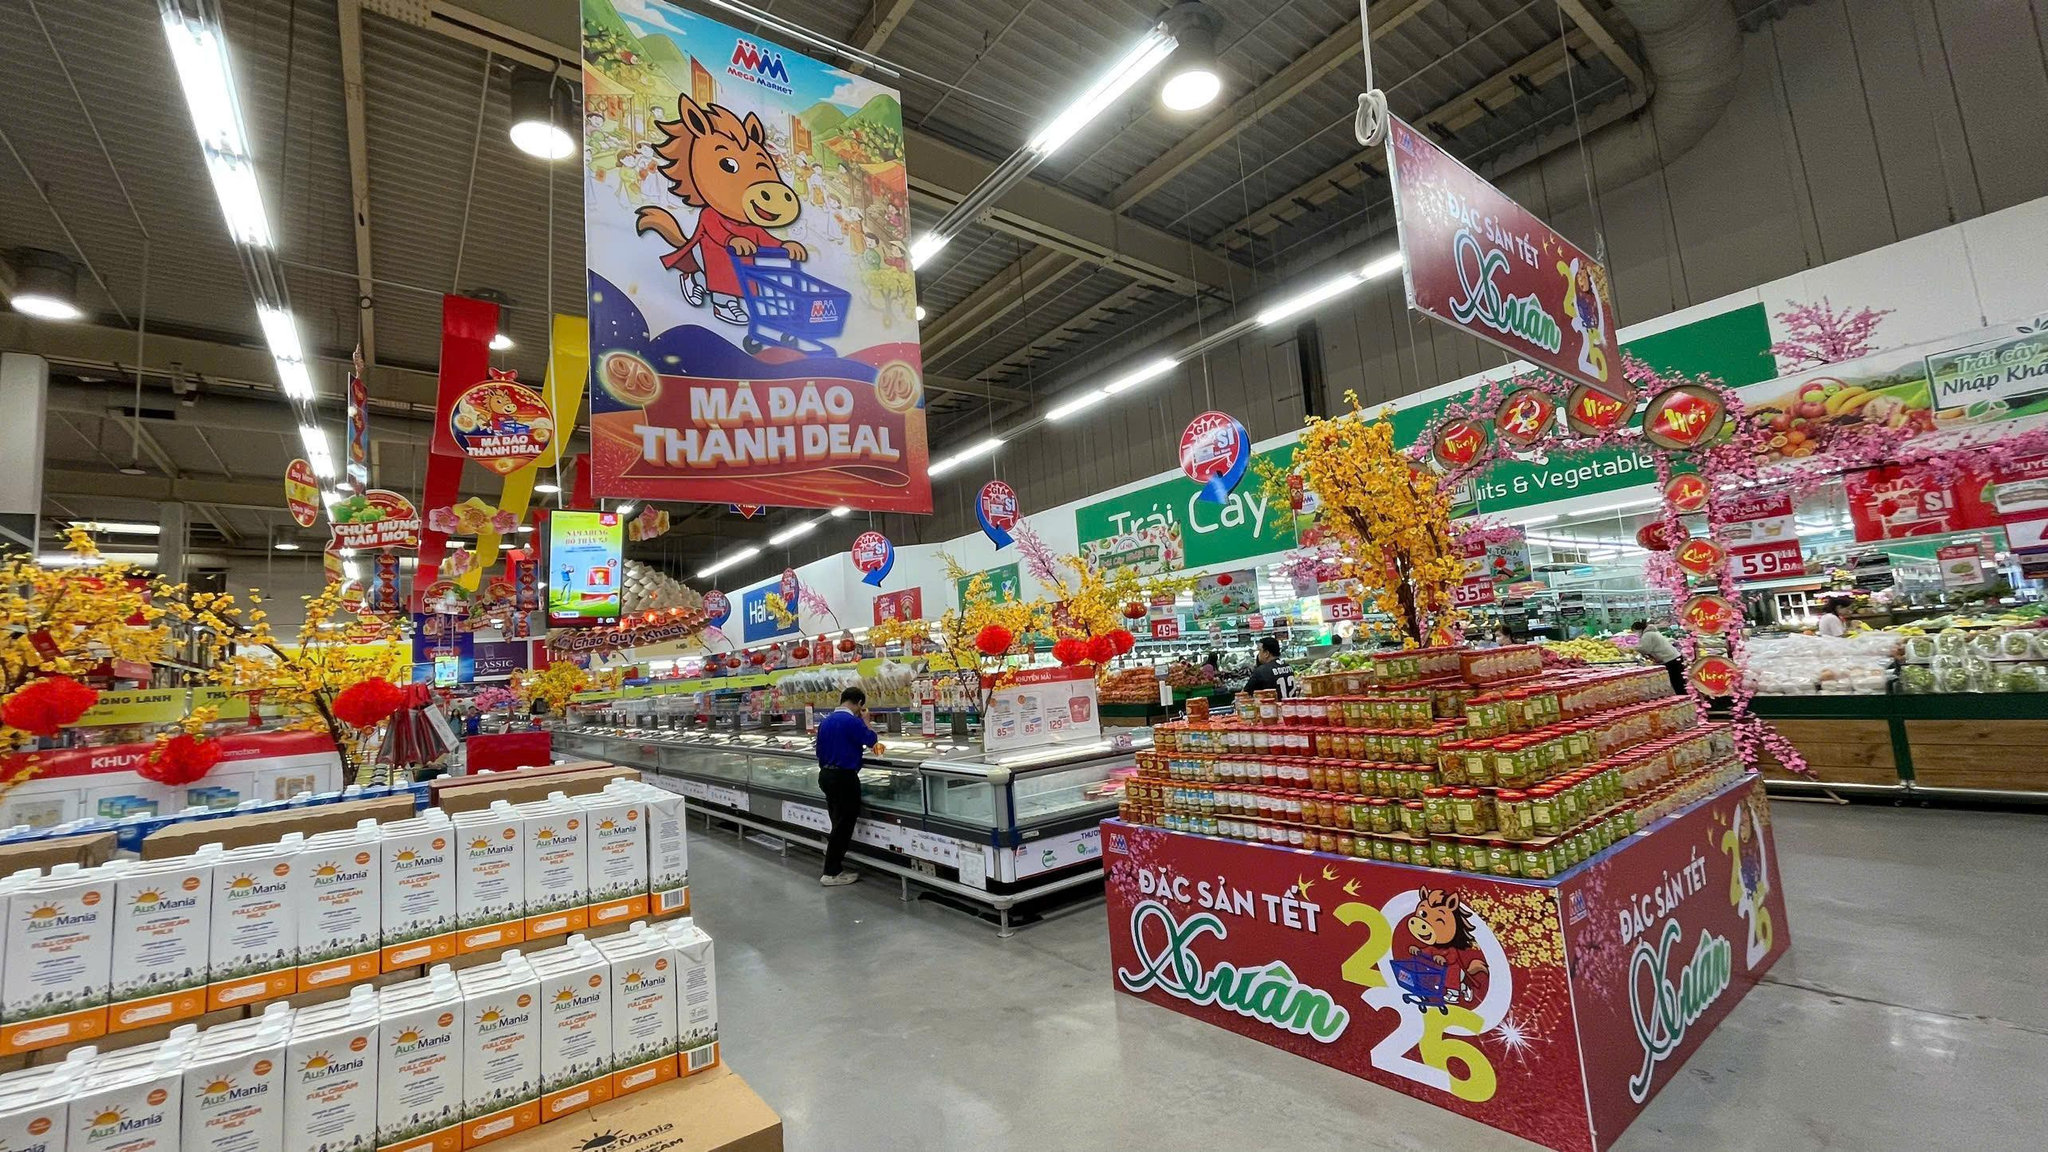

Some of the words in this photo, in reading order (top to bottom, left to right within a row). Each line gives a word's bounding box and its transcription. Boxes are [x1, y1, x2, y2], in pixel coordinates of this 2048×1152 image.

[1446, 192, 1482, 234] ĐẶC
[1485, 217, 1515, 258] SẢN
[1515, 234, 1539, 269] TẾT
[1449, 227, 1562, 355] Xuân
[1955, 349, 1997, 374] Trái
[1999, 341, 2043, 365] cây
[1943, 373, 2000, 397] Nhập
[633, 423, 795, 467] THÀNH
[802, 424, 900, 463] DEAL
[1514, 476, 1530, 494] &
[1531, 452, 1654, 490] Vegetable
[1742, 553, 1777, 574] 59
[1331, 603, 1350, 618] 65
[1157, 624, 1171, 638] 49
[474, 659, 513, 669] LASSIC
[1276, 675, 1297, 698] 12
[997, 727, 1007, 737] 85
[1025, 723, 1034, 733] 85
[1049, 719, 1062, 730] 129
[536, 839, 552, 848] Aus
[552, 834, 577, 845] Mania
[598, 829, 613, 839] Aus
[613, 825, 638, 836] Mania
[469, 848, 486, 859] Aus
[487, 844, 513, 856] Mania
[395, 859, 412, 870] Aus
[413, 855, 444, 867] Mania
[314, 873, 335, 886] Aus
[336, 869, 368, 883] Mania
[228, 889, 250, 900] Aus
[252, 882, 286, 896] Mania
[1138, 867, 1192, 906] ĐẶC
[1197, 875, 1256, 919] SẢN
[1262, 885, 1321, 933] TẾT
[1618, 894, 1655, 948] ĐẶC
[1654, 869, 1685, 919] SẢN
[1683, 845, 1708, 897] TẾT
[132, 904, 157, 915] Aus
[159, 897, 196, 910] Mania
[27, 919, 54, 931] Aus
[56, 912, 97, 927] Mania
[1118, 899, 1350, 1043] Xuân
[624, 983, 640, 993] Aus
[641, 975, 666, 989] Mania
[554, 1001, 571, 1012] Aus
[573, 992, 600, 1006] Mania
[627, 1001, 644, 1009] FULL
[644, 995, 663, 1006] CREAM
[638, 1003, 654, 1011] MILK
[1628, 917, 1732, 1104] Xuân
[479, 1023, 497, 1034] Aus
[499, 1013, 529, 1028] Mania
[558, 1019, 575, 1028] FULL
[575, 1012, 597, 1024] CREAM
[570, 1021, 586, 1030] MILK
[395, 1044, 415, 1056] Aus
[418, 1034, 451, 1049] Mania
[482, 1042, 501, 1051] FULL
[501, 1034, 525, 1047] CREAM
[495, 1044, 513, 1053] MILK
[302, 1069, 326, 1082] Aus
[328, 1058, 365, 1075] Mania
[399, 1064, 418, 1074] FULL
[418, 1055, 446, 1068] CREAM
[413, 1066, 432, 1076] MILK
[201, 1094, 227, 1108] Aus
[229, 1082, 268, 1100] Mania
[306, 1090, 329, 1101] FULL
[328, 1082, 358, 1096] CREAM
[322, 1094, 343, 1103] MILK
[205, 1117, 229, 1128] FULL
[229, 1107, 262, 1122] CREAM
[222, 1118, 246, 1130] MILK
[88, 1126, 116, 1140] Aus
[119, 1115, 162, 1133] Mania
[619, 1122, 674, 1146] Mania
